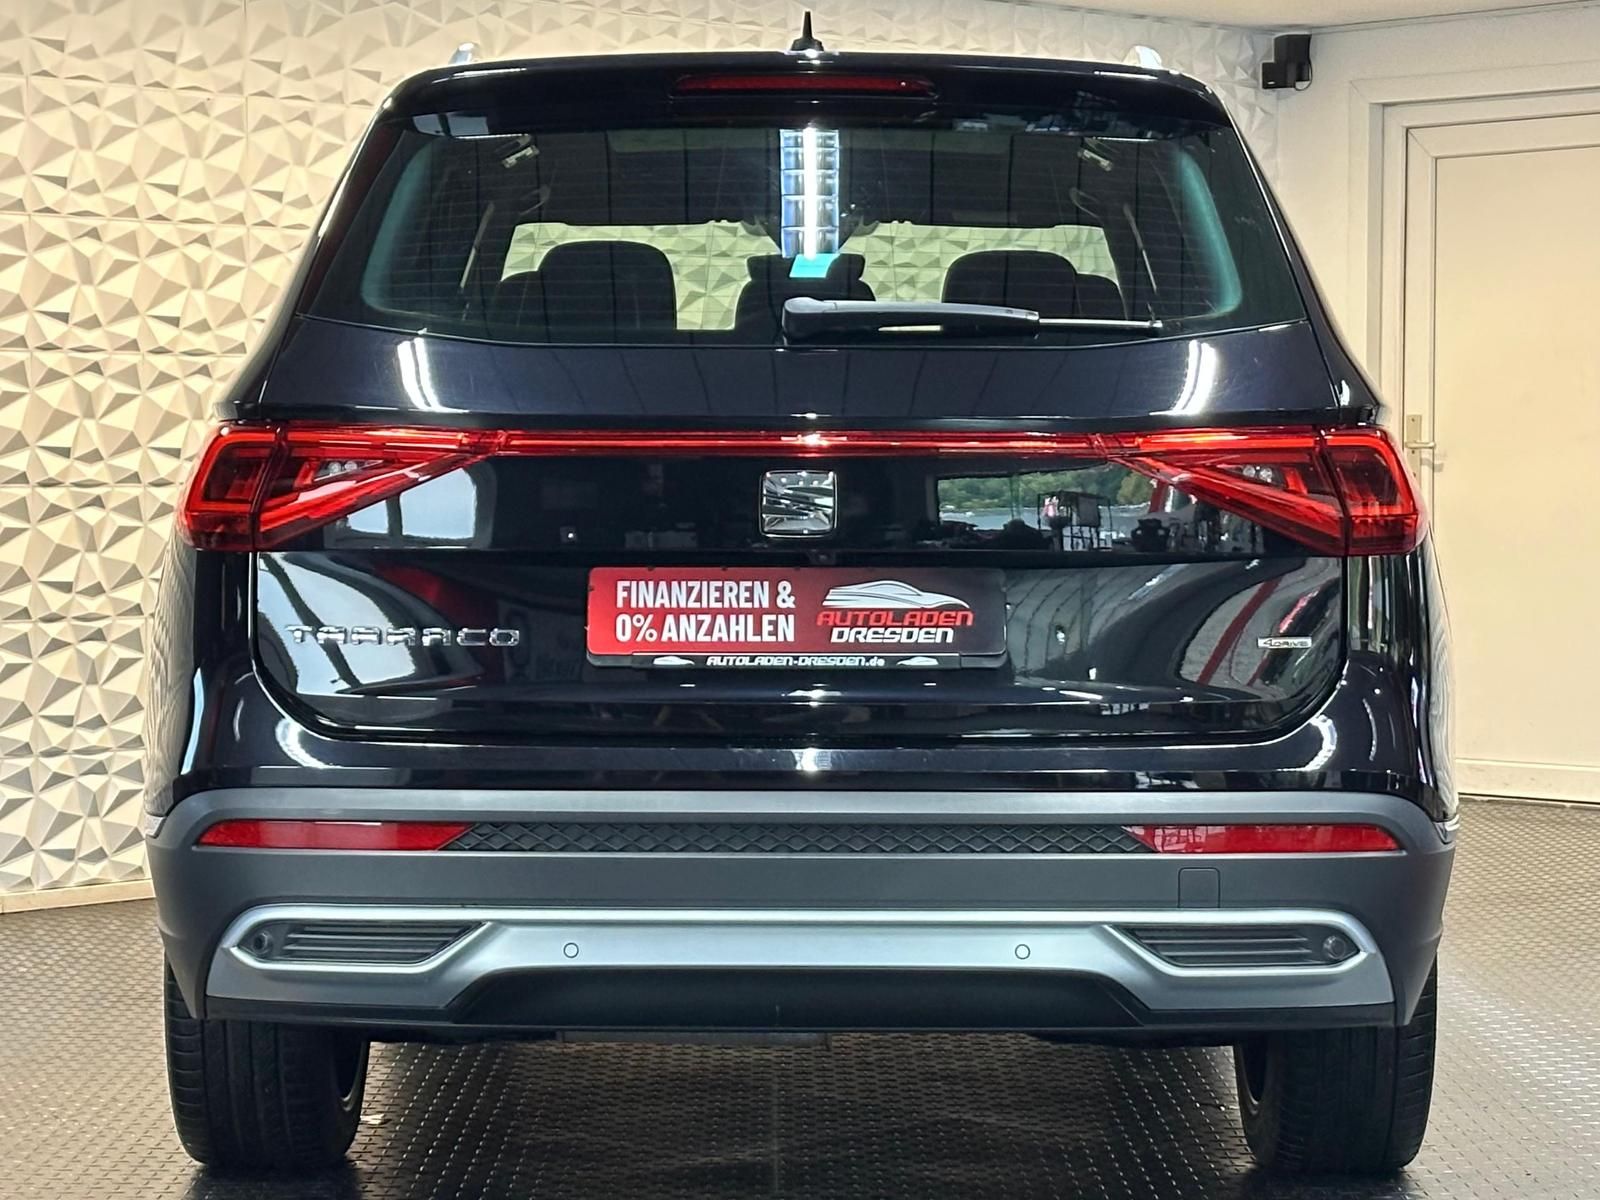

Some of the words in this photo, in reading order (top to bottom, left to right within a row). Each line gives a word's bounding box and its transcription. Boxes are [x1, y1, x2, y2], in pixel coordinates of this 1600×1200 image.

[616, 580, 769, 608] FINANZIEREN
[776, 580, 796, 608] &
[616, 614, 657, 642] 0%
[662, 614, 795, 642] ANZAHLEN
[816, 611, 973, 626] AUTOLADEN
[285, 625, 520, 647] TARRACO
[830, 627, 954, 643] DRESDEN
[706, 656, 885, 667] AUTOLADEN-DRESDEN.de
